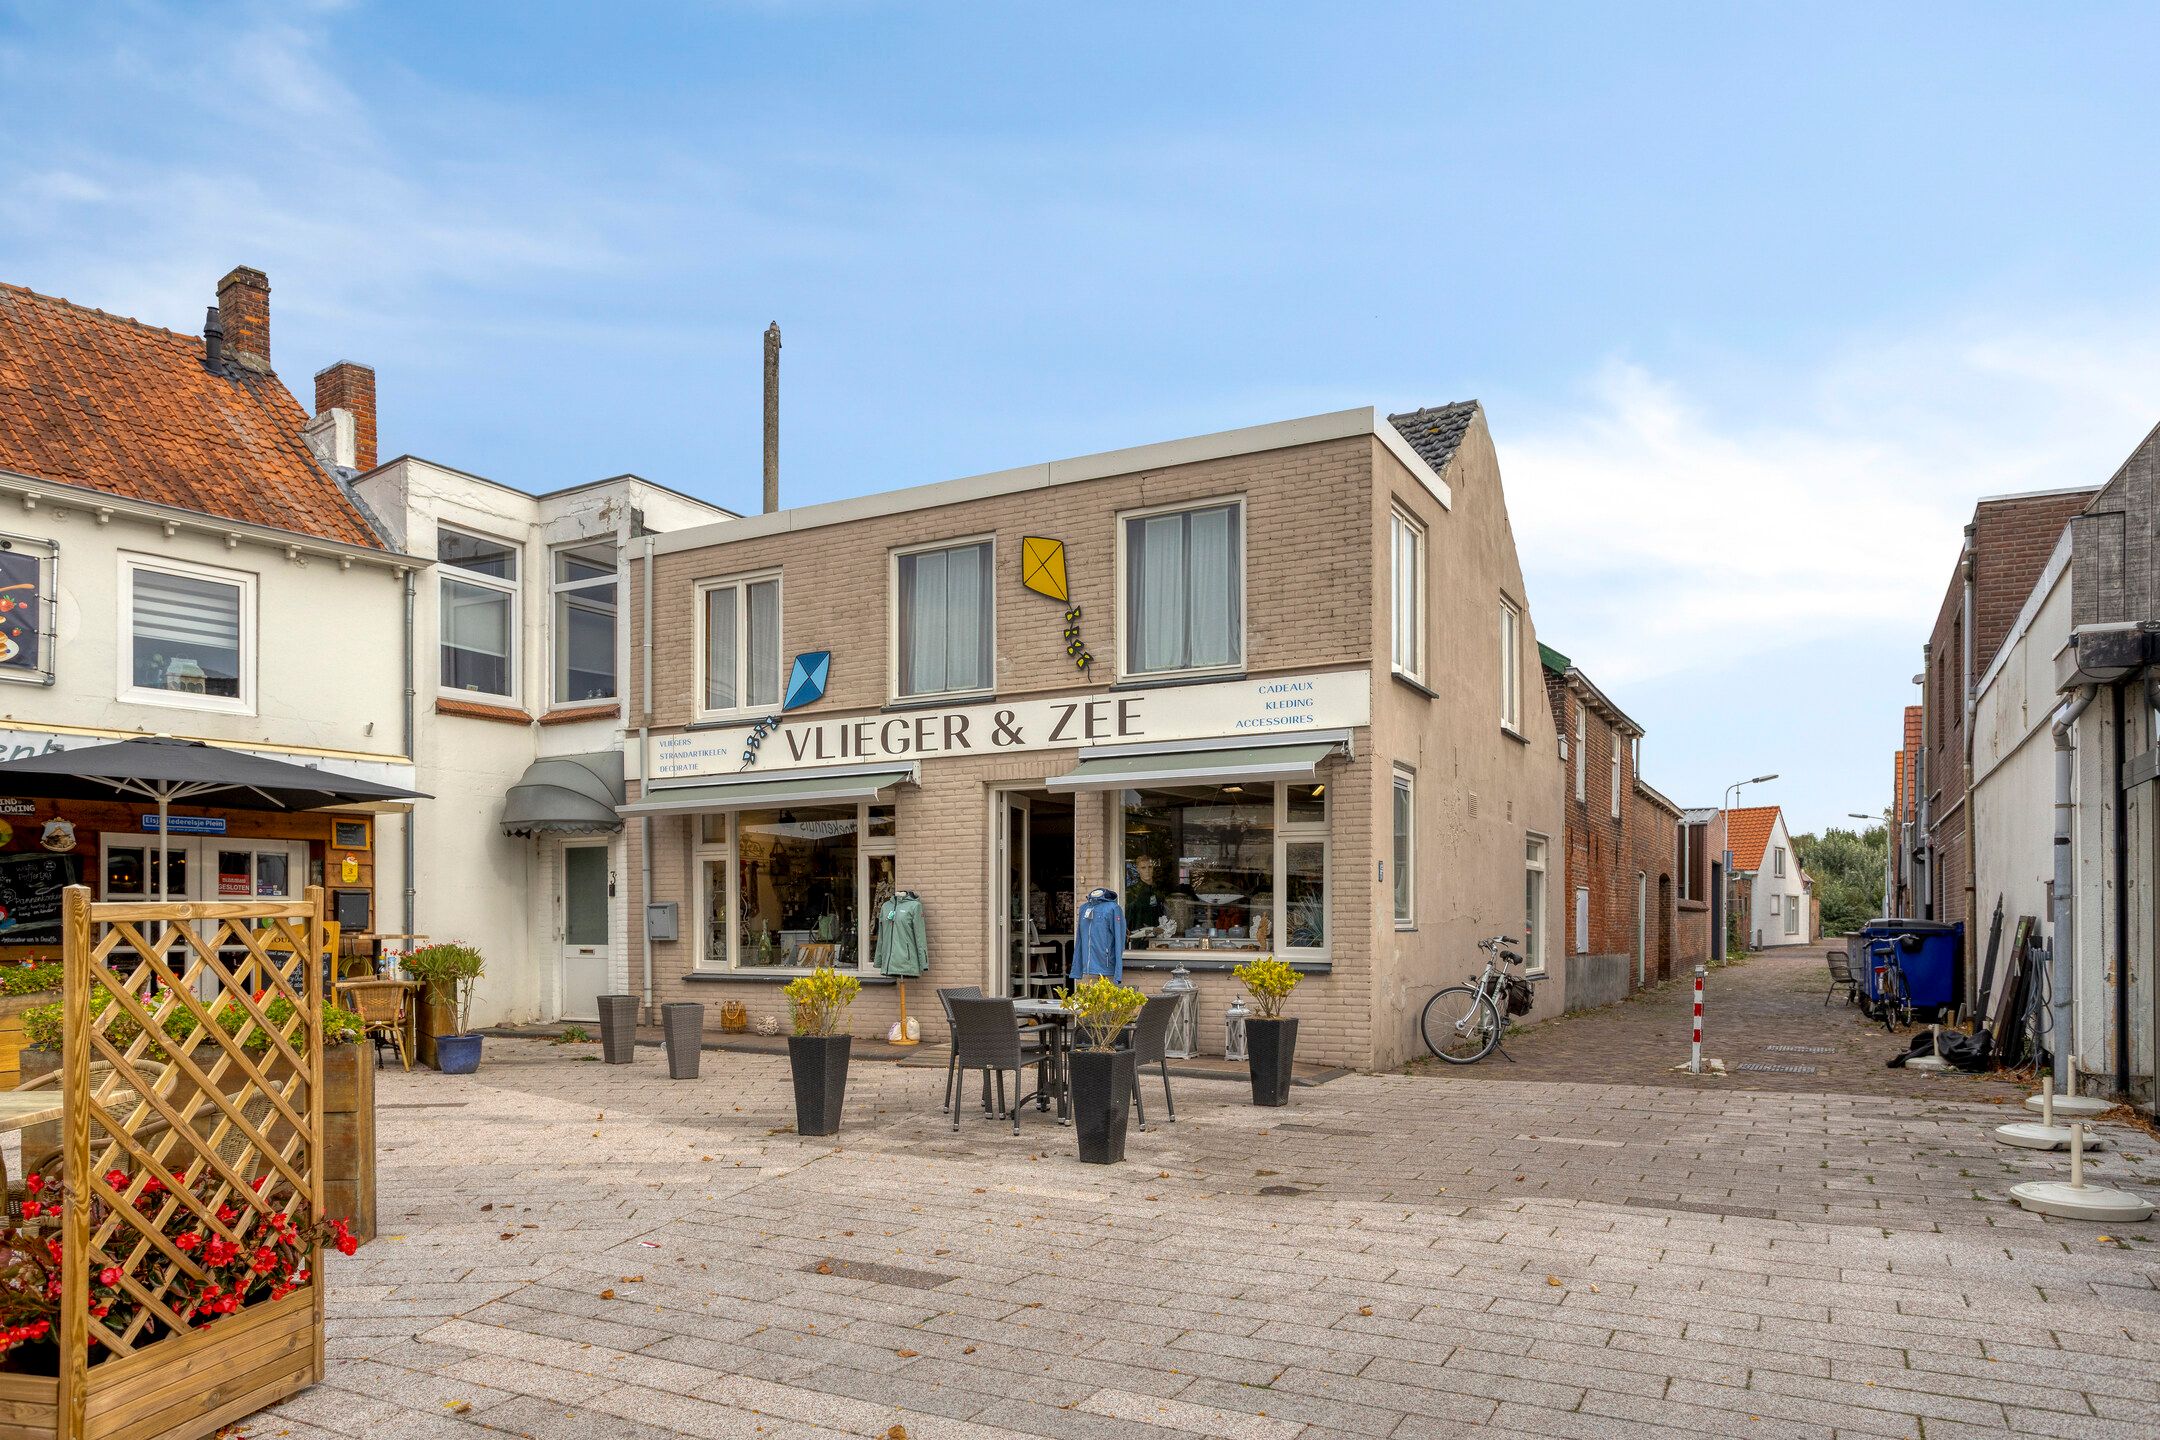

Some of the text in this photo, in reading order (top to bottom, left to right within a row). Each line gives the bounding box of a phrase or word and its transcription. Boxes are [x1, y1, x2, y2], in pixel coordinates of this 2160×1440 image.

[1258, 682, 1313, 694] CADEAUX
[1265, 698, 1314, 710] KLEDING
[1235, 714, 1314, 728] ACCESSOIRES
[785, 697, 1145, 762] VLIEGER & ZEE
[659, 738, 692, 748] VLIEGERS
[659, 748, 728, 760] STRANDARTIKELEN
[659, 763, 698, 773] DECORATIE
[144, 816, 161, 826] Elsj
[167, 819, 205, 828] iederelsje
[610, 870, 617, 885] 3
[218, 883, 250, 891] GESLOTEN
